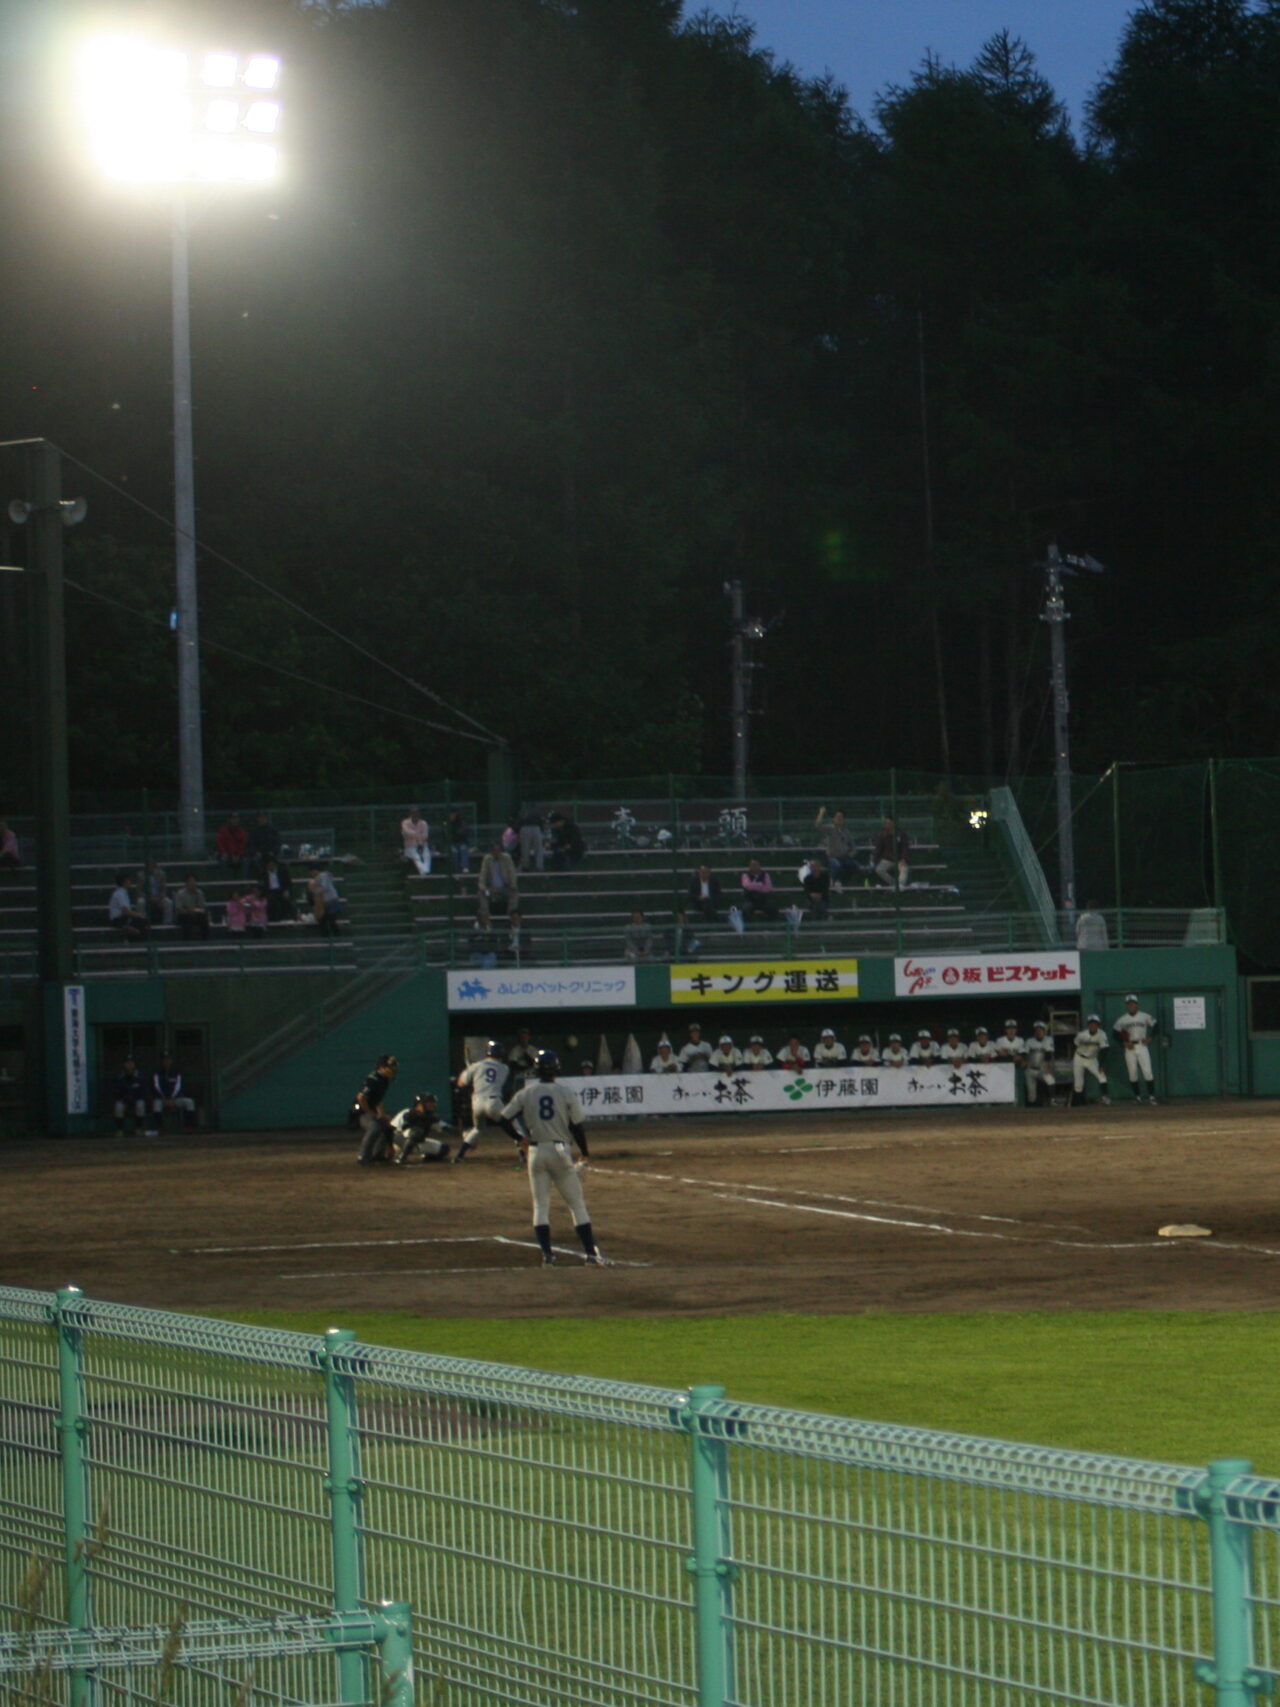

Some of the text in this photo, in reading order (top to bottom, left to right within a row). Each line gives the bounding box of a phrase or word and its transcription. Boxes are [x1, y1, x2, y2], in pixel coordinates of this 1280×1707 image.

[690, 969, 840, 996] キング運送
[485, 1067, 497, 1084] 9
[580, 1085, 644, 1105] 伊藤園
[815, 1077, 879, 1097] 伊藤園
[538, 1095, 555, 1121] 8
